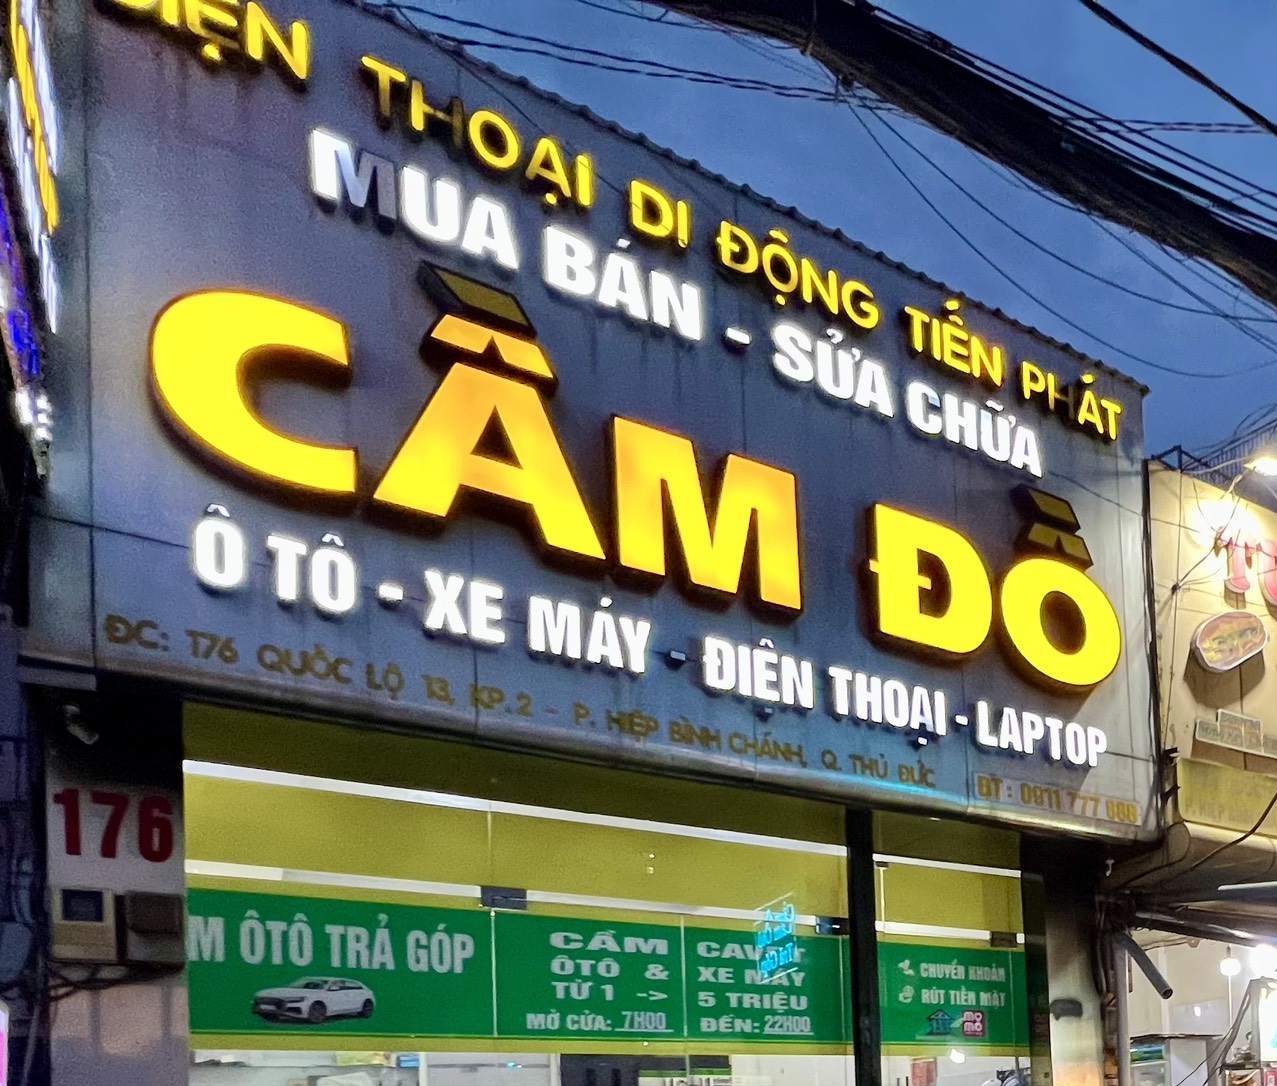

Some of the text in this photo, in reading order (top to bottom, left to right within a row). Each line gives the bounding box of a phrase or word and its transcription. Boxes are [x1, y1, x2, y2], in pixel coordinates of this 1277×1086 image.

[361, 54, 593, 207] THOẠI
[629, 179, 690, 248] DI
[715, 229, 881, 330] ĐỘNG
[1020, 360, 1122, 441] PHÁT
[309, 127, 519, 271] MUA
[545, 225, 703, 341] BÁN
[771, 321, 895, 419] SỬA
[906, 380, 1043, 478] CHỮA
[150, 262, 802, 610] CẦM
[869, 485, 1122, 686] ĐỒ
[192, 503, 246, 590] Ô
[266, 532, 357, 614] TÔ
[424, 569, 506, 645] XE
[528, 595, 652, 676] MÁY
[828, 667, 947, 746] THOẠI
[974, 699, 1109, 768] LAPTOP
[104, 614, 170, 651] ĐC:
[185, 628, 238, 665] 176
[257, 643, 354, 685] QUỐC
[365, 661, 405, 701] LỘ
[669, 714, 723, 751] BÌNH
[848, 753, 888, 780] THỦ
[53, 787, 174, 864] 176
[1020, 783, 1062, 811] 0911
[1068, 792, 1100, 818] 777
[239, 909, 315, 968] ÔTÔ
[324, 913, 396, 972] TRẢ
[405, 923, 475, 975] GÓP
[550, 954, 621, 978] ÔTÔ
[643, 963, 670, 981] &
[697, 966, 735, 984] XE
[526, 1008, 560, 1030] MỞ
[620, 1010, 667, 1032] 7H00
[600, 984, 614, 1001] 1
[697, 991, 716, 1007] 5
[725, 991, 809, 1013] TRIỆU
[921, 986, 946, 1005] RÚT
